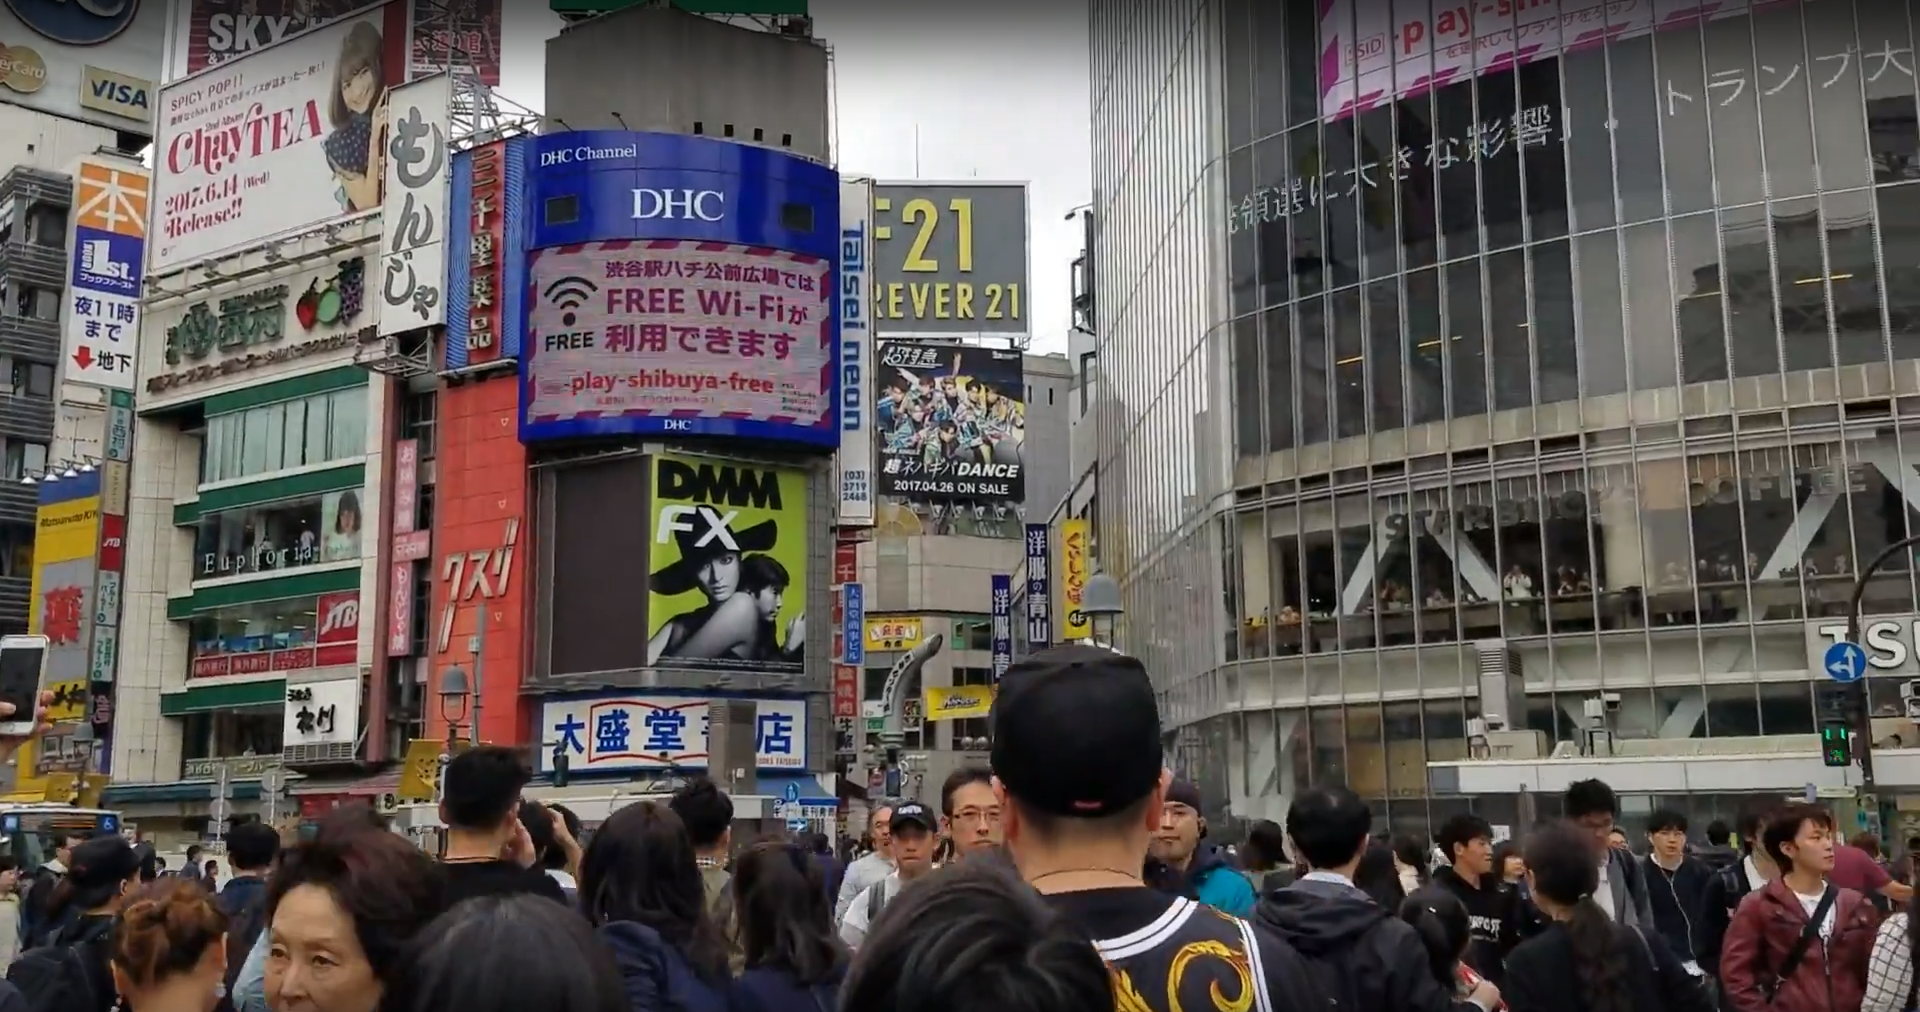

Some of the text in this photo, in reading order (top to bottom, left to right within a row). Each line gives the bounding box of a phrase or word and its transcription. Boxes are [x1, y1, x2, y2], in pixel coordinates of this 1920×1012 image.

[91, 78, 149, 110] VISA
[171, 73, 243, 112] SPICY POP!!
[205, 114, 244, 133] 2nd Album
[541, 144, 638, 167] DHC Channel
[165, 169, 270, 216] 2017.6.14 (Wed)
[630, 188, 724, 221] DHC
[164, 197, 243, 239] Release!!
[383, 105, 443, 322] もんじゃ
[605, 259, 816, 293] 渋谷駅ハチ公前広場では
[74, 295, 136, 325] 夜11時
[606, 287, 808, 326] FREE Wi-Fiが
[985, 282, 1019, 319] 21
[84, 318, 122, 344] まで
[604, 323, 797, 361] 利用できます
[842, 219, 866, 431] Taisei neon
[545, 334, 594, 353] FREE
[96, 348, 134, 375] 地下
[664, 419, 692, 431] DHC
[657, 458, 783, 511] DMM
[842, 481, 867, 492] 3719
[844, 470, 866, 482] (03)
[893, 480, 1009, 495] 2017.04.26 ON SALE
[656, 504, 740, 551] FX
[203, 543, 313, 575] Euphoria
[437, 517, 520, 654] クスリ
[1028, 529, 1048, 643] 洋服の青山
[320, 598, 358, 635] JTB
[553, 708, 794, 755] 大盛堂店
